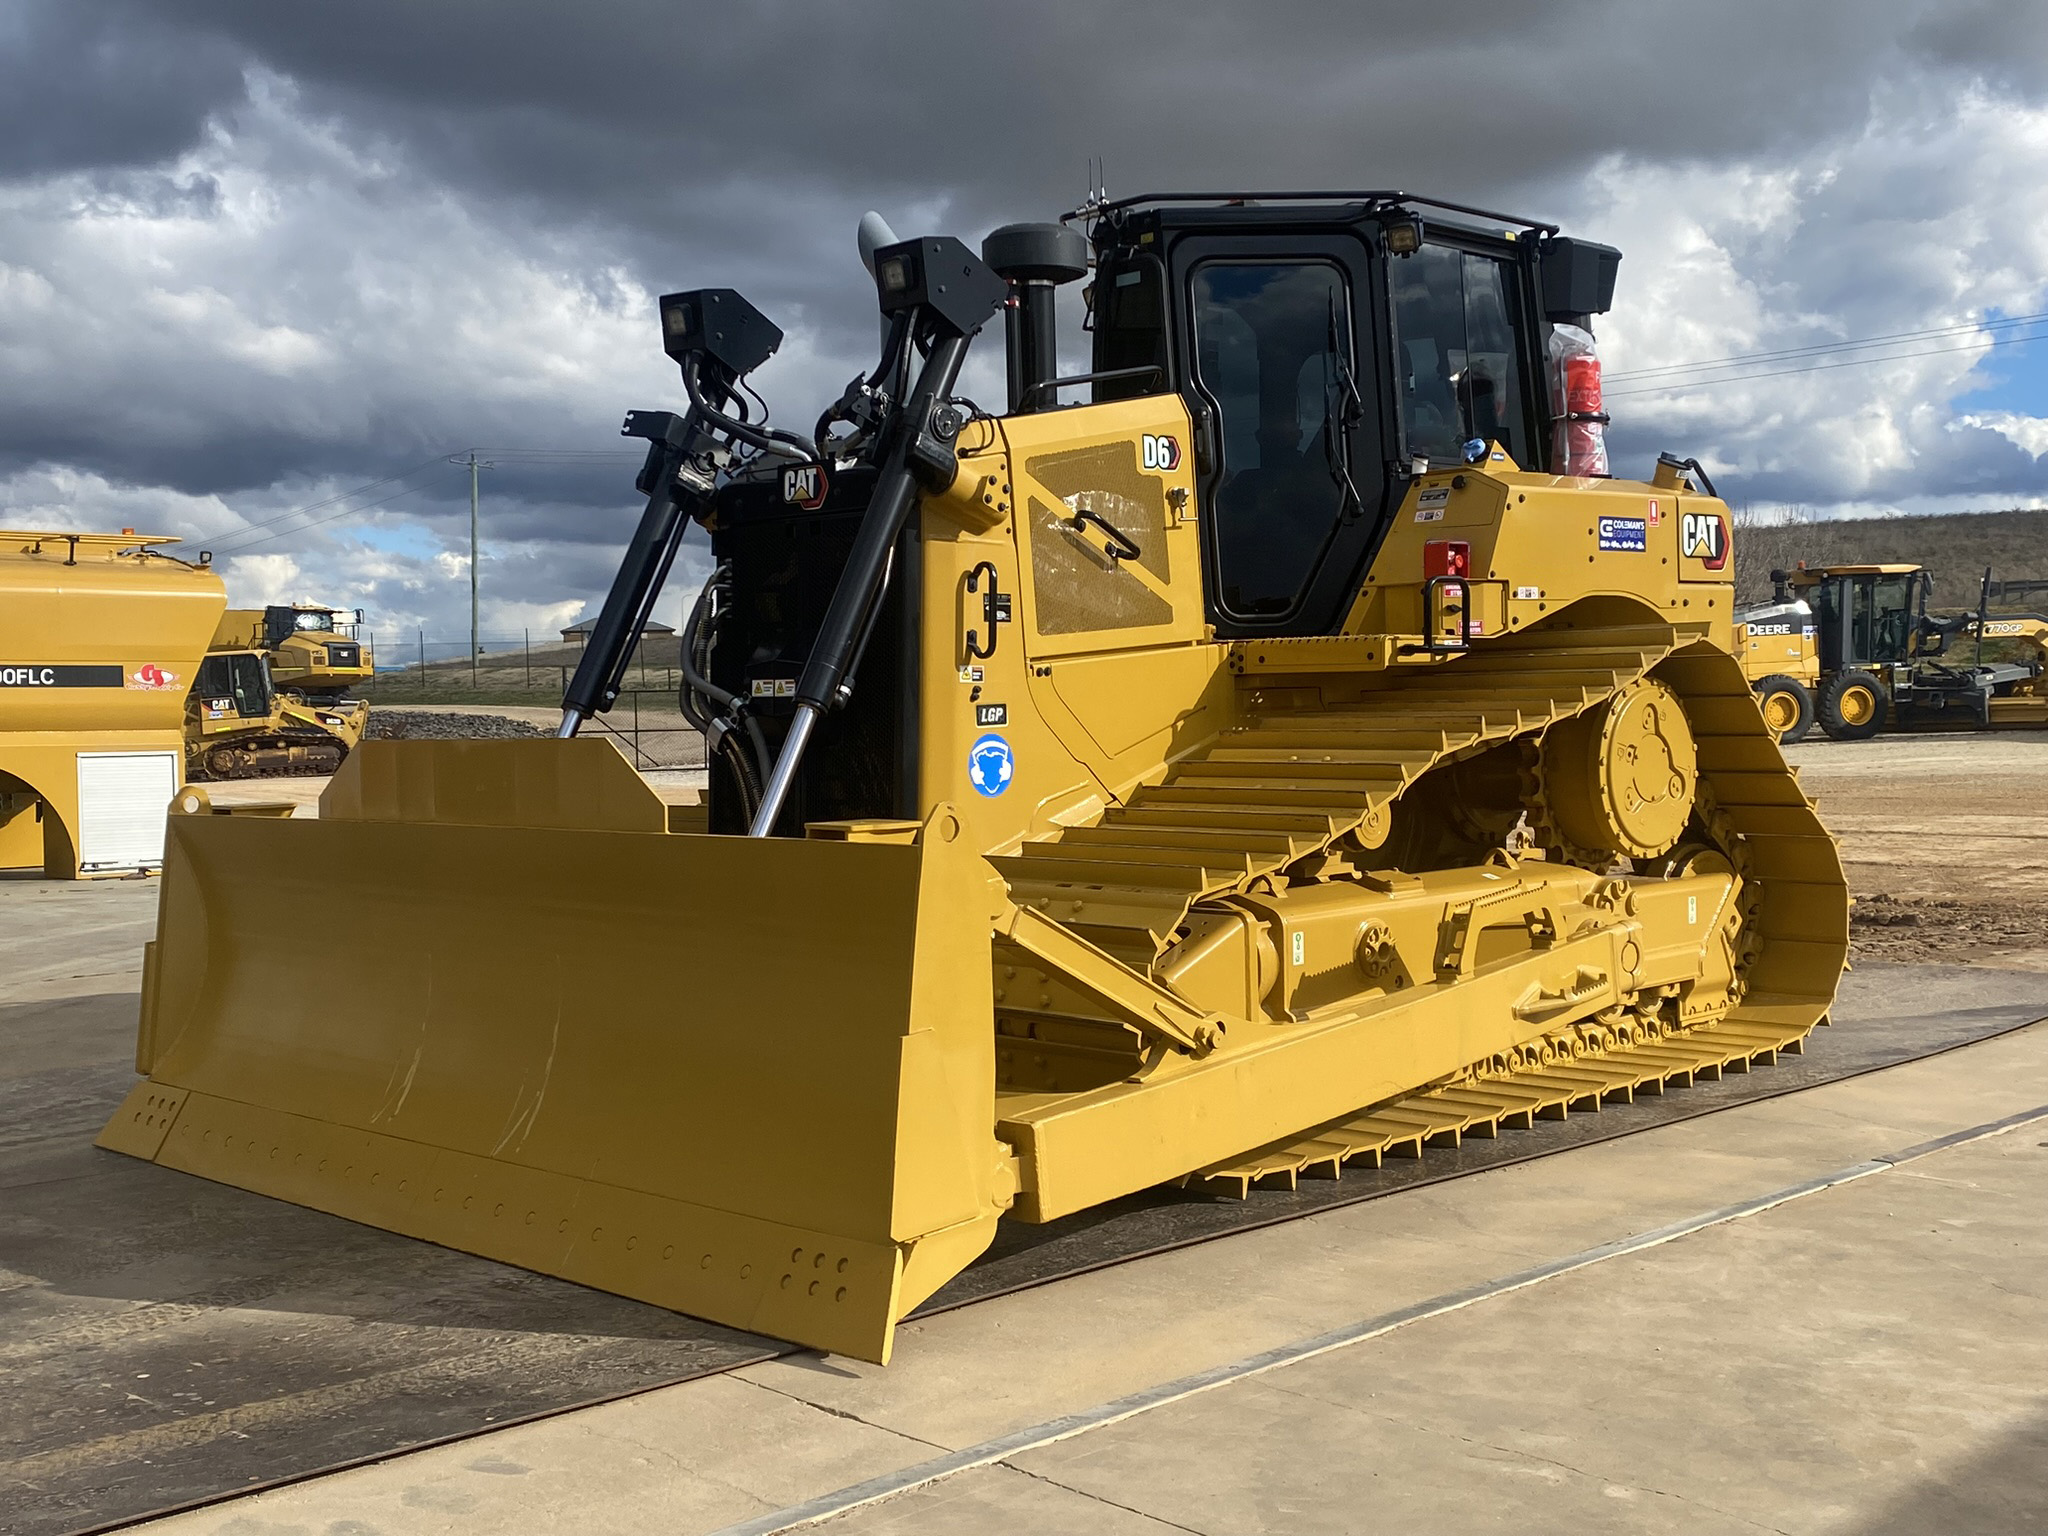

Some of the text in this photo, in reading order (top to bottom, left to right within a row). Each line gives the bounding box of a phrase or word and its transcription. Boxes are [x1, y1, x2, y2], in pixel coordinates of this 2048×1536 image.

[1143, 435, 1170, 469] D6
[784, 467, 817, 501] CAT
[1682, 513, 1718, 557] CAT
[1747, 623, 1791, 636] DEERE
[0, 668, 55, 685] 0FLC
[212, 699, 230, 711] CAT
[981, 706, 1004, 723] LGP
